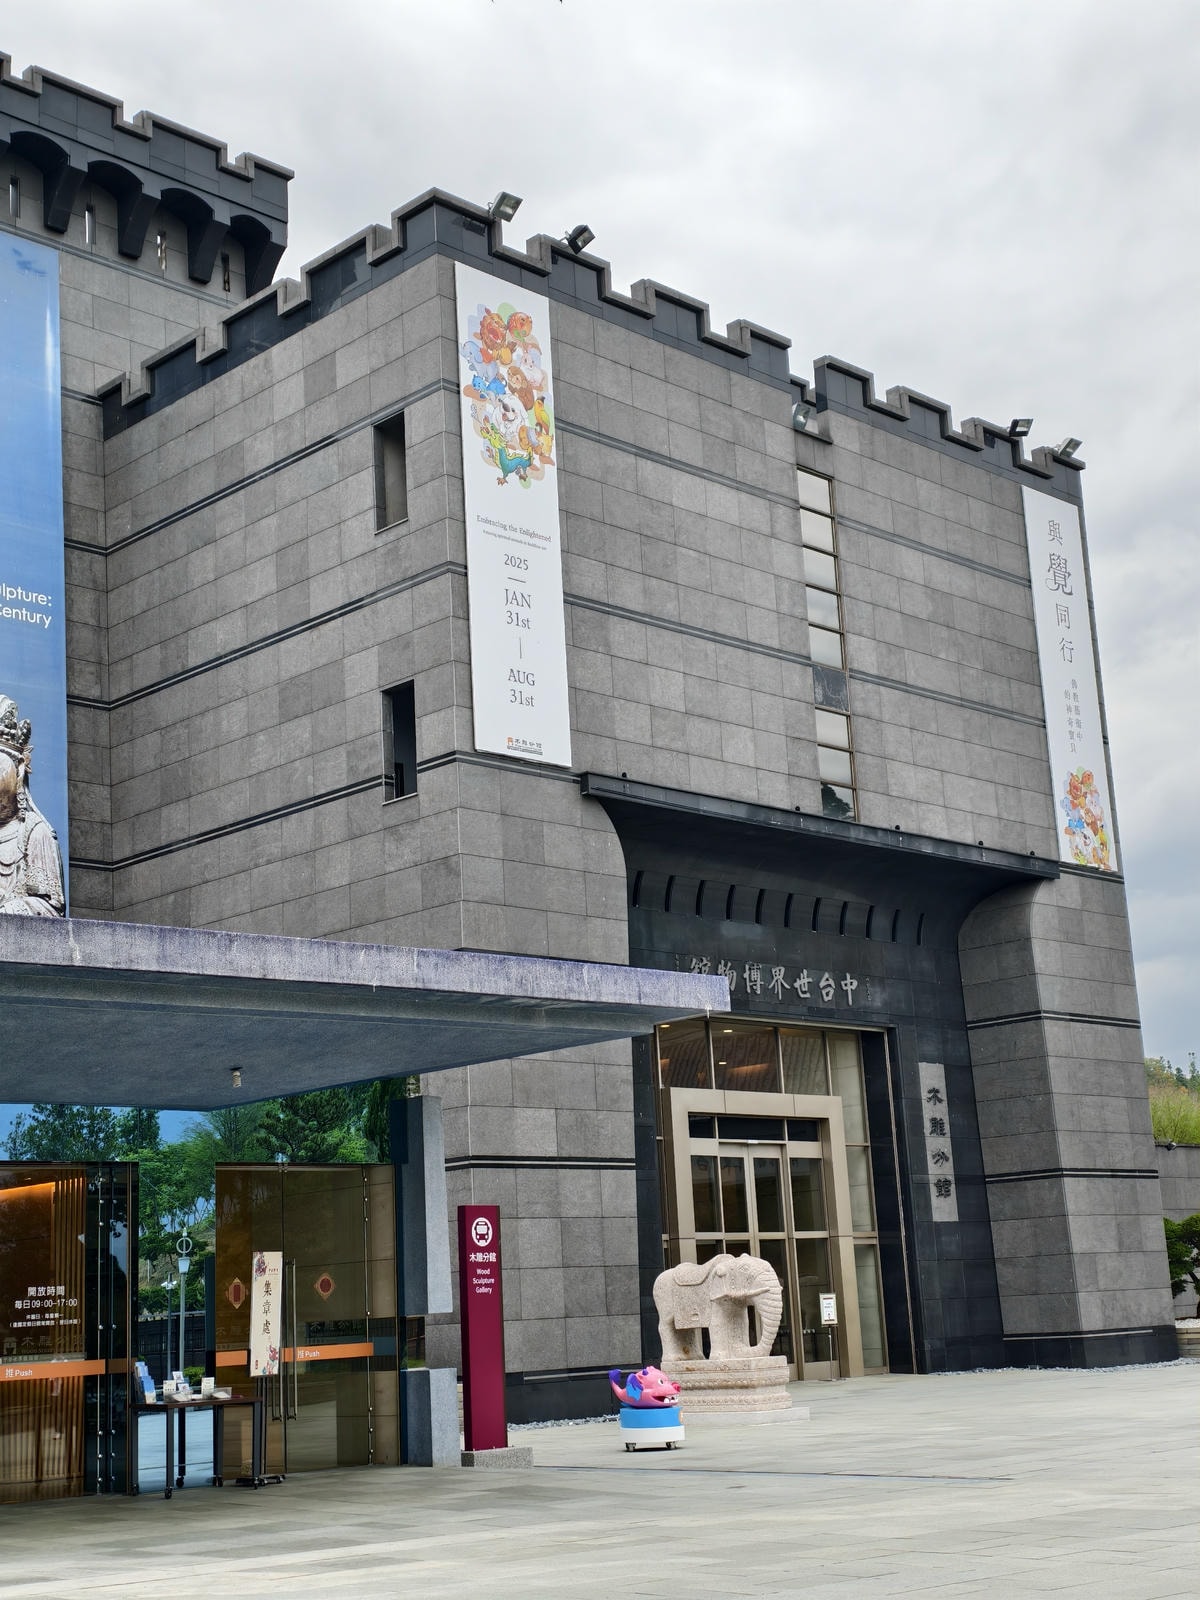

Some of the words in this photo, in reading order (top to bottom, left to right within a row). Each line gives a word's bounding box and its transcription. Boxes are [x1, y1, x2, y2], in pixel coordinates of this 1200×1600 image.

[503, 553, 529, 571] 2025
[0, 582, 53, 608] lpture:
[504, 588, 532, 609] JAN
[1045, 519, 1075, 664] 與覺同行
[0, 603, 53, 629] entury
[506, 610, 532, 630] 31st
[507, 668, 536, 687] AUG
[509, 688, 535, 708] 31st
[926, 1087, 953, 1199] 木雕分館
[469, 1252, 497, 1263] 木雕分館
[472, 1277, 495, 1285] Sculpture
[475, 1286, 493, 1294] Gallery
[27, 1285, 66, 1297] 開放時間
[305, 1350, 321, 1358] Push
[15, 1368, 33, 1378] Push
